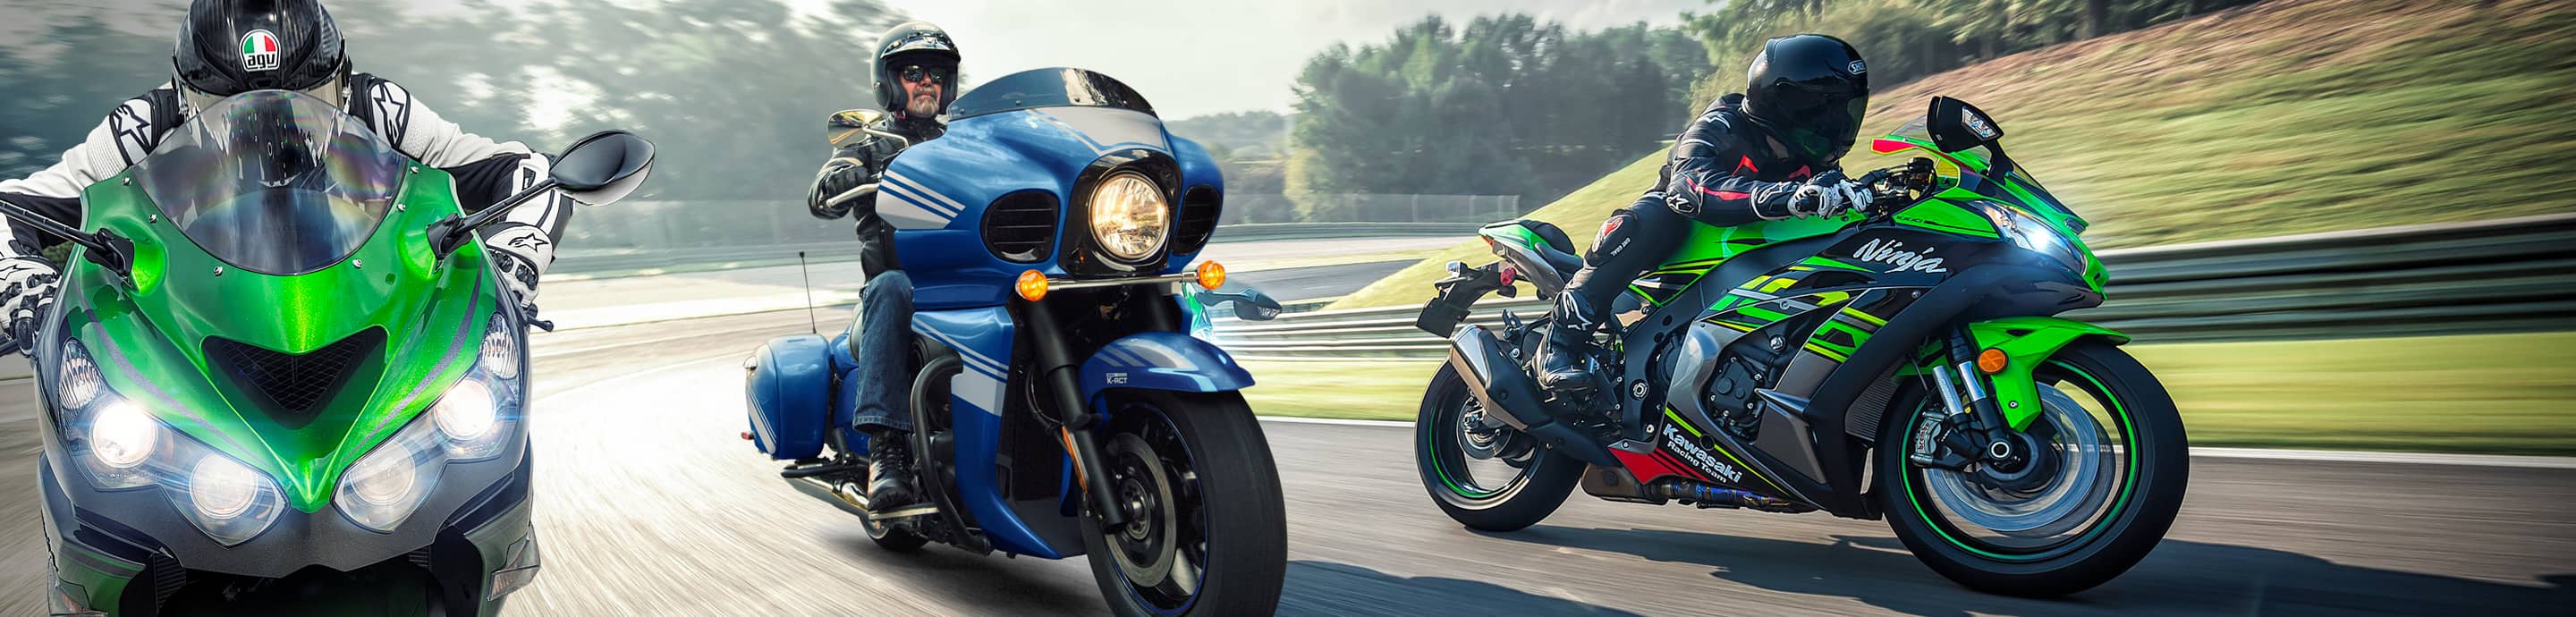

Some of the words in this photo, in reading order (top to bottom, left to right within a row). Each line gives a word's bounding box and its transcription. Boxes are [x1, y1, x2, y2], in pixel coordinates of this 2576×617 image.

[248, 54, 275, 68] agv
[1853, 238, 1946, 273] Ninja
[1663, 423, 1743, 483] Kawasaki
[1667, 441, 1699, 467] Racing
[1701, 462, 1727, 483] Team
